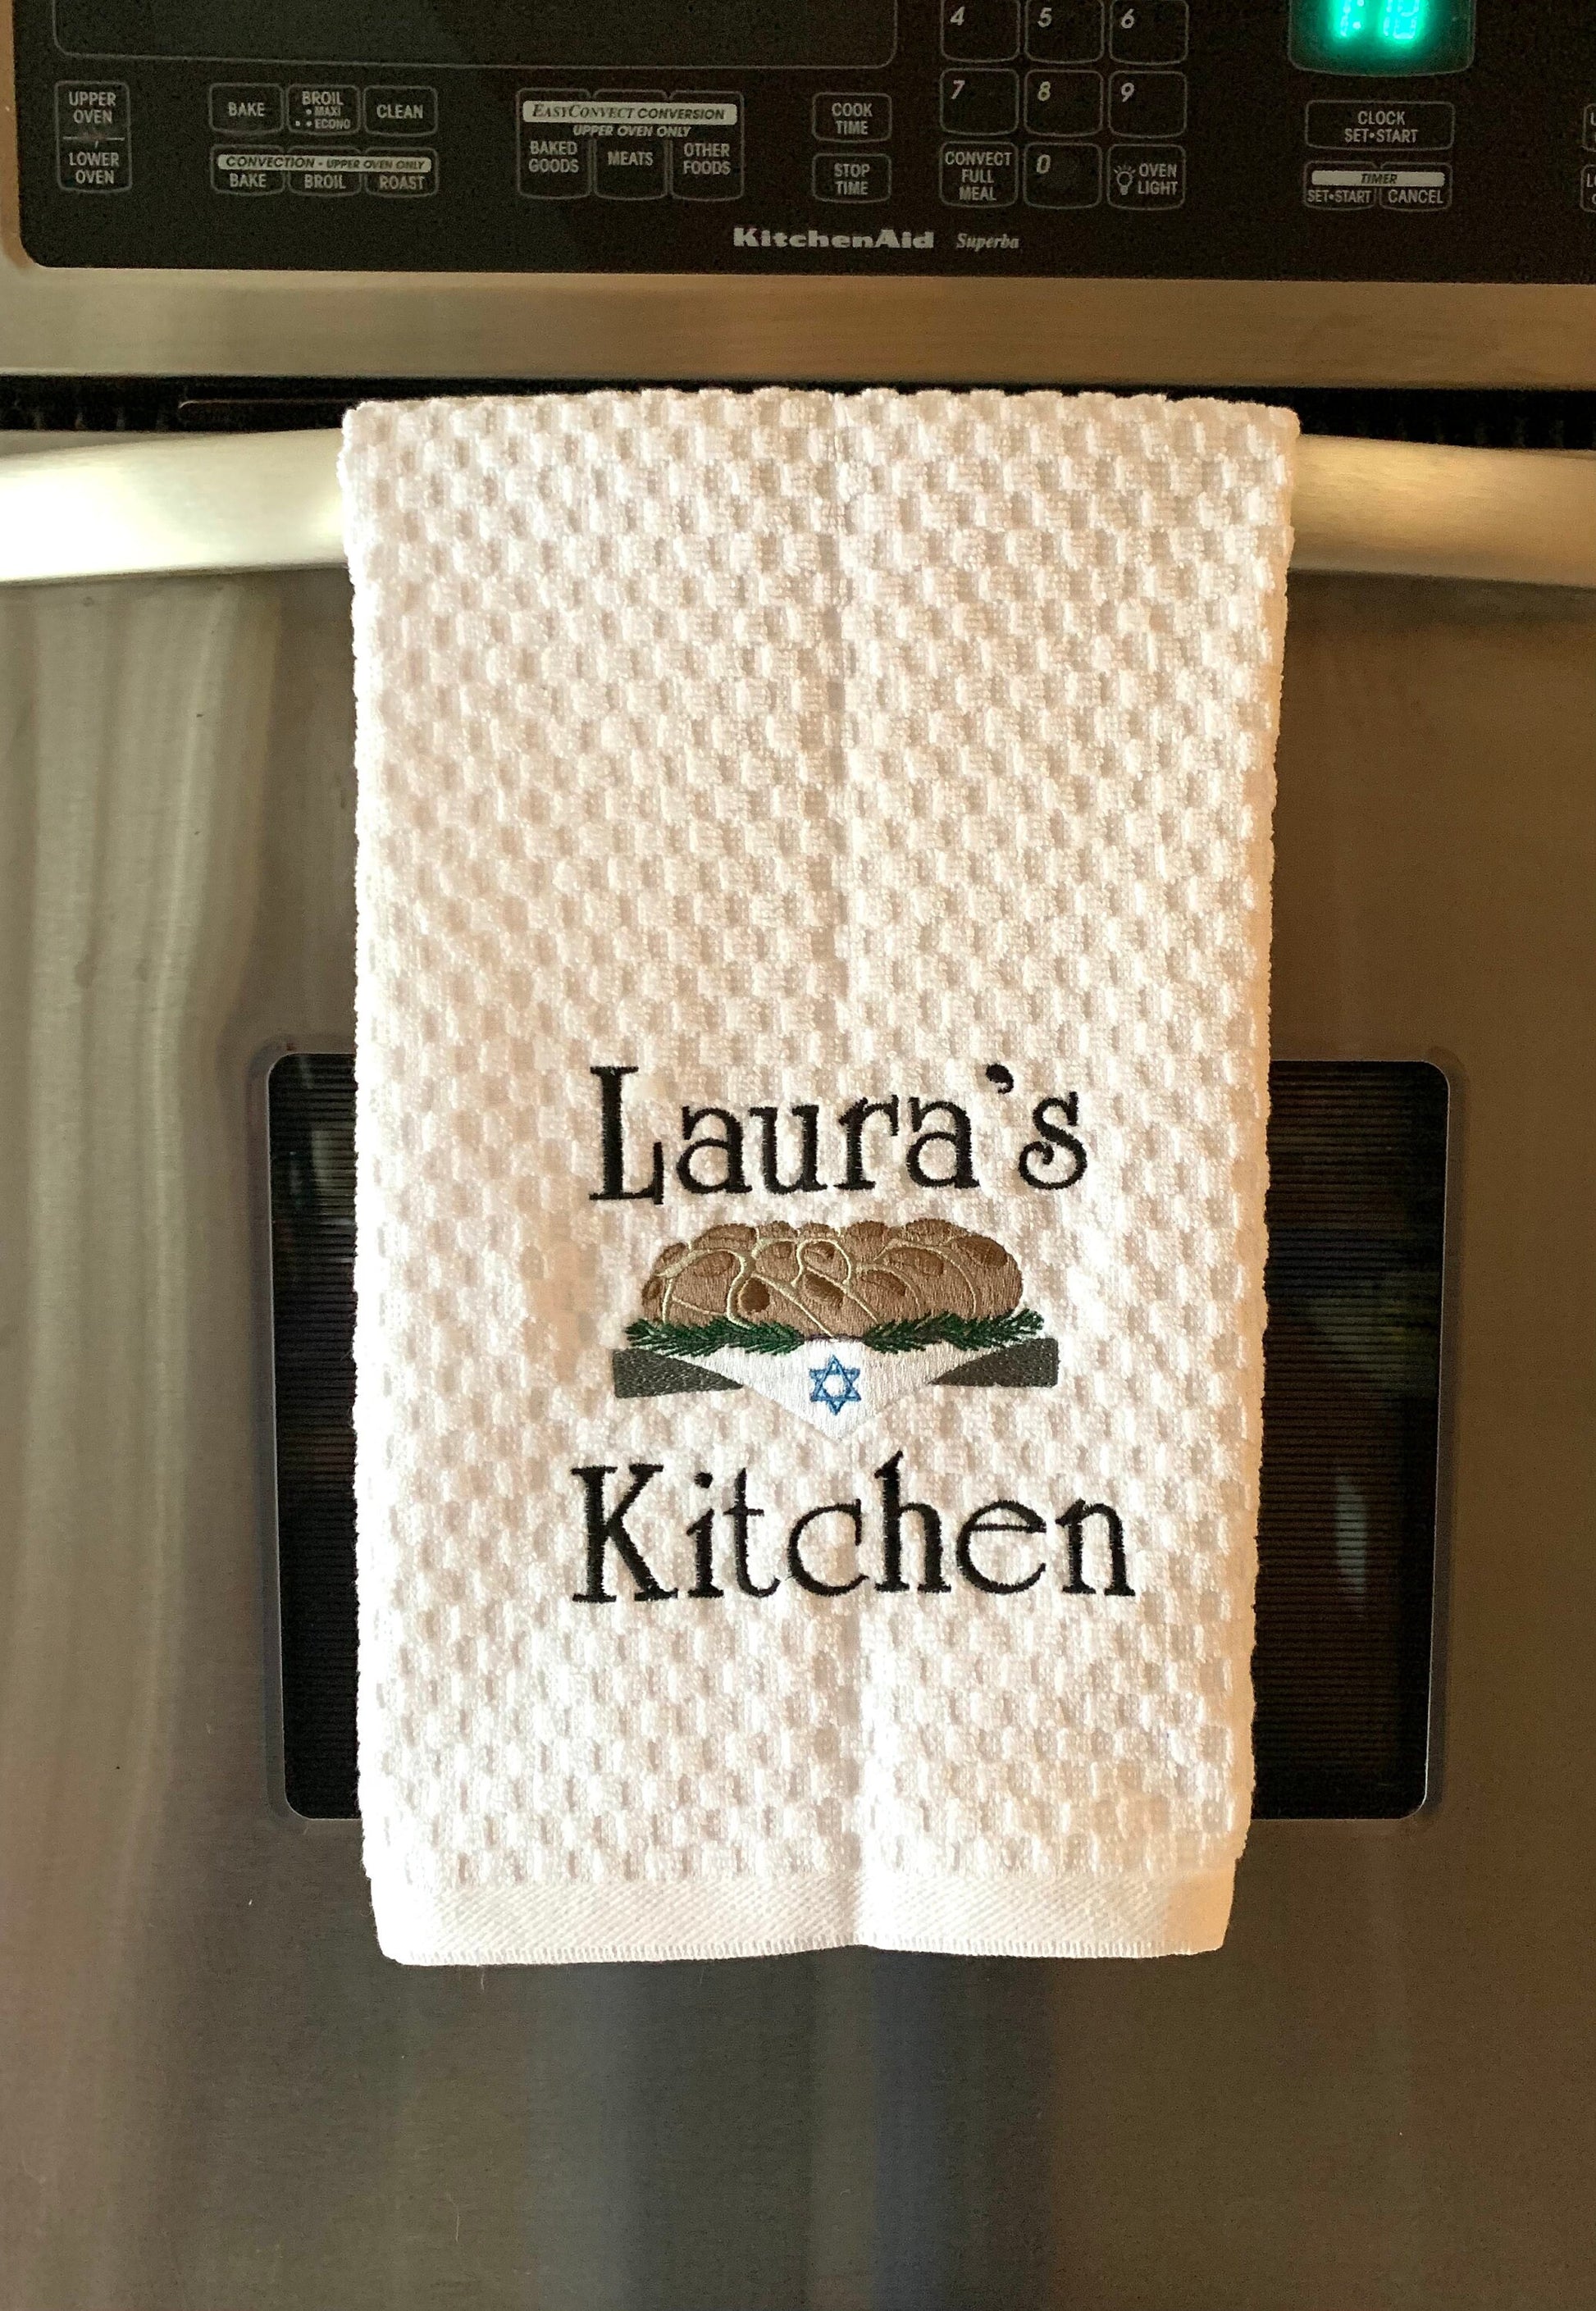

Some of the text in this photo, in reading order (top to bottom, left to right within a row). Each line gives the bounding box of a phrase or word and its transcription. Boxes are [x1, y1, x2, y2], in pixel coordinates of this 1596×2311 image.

[950, 6, 965, 25] 4
[1037, 7, 1052, 28] 5
[1120, 8, 1135, 29] 6
[951, 80, 965, 99] 7
[1037, 80, 1051, 101] 8
[1120, 82, 1135, 102] 9
[69, 91, 116, 107] UPPER
[302, 91, 344, 106] BROIL
[73, 109, 113, 125] OVEN
[228, 102, 266, 116] BAKE
[376, 104, 424, 120] CLEAN
[637, 107, 725, 120] CONVERSION
[832, 103, 873, 117] COOK
[1357, 111, 1406, 125] CLOCK
[573, 125, 691, 138] UPPER OVEN ONLY
[837, 121, 869, 135] TIME
[530, 140, 578, 156] BAKED
[683, 142, 731, 157] OTHER
[69, 153, 120, 168] LOWER
[226, 155, 315, 169] CONVECTION
[326, 157, 361, 169] UPPER
[363, 158, 394, 170] OVEN
[395, 159, 426, 171] ONLY
[528, 158, 580, 174] GOODS
[607, 151, 654, 166] MEATS
[944, 151, 1013, 166] CONVECT
[682, 160, 732, 175] FOODS
[833, 163, 871, 178] STOP
[1138, 162, 1178, 178] OVEN
[75, 170, 115, 185] OVEN
[229, 172, 267, 188] BAKE
[303, 174, 346, 189] BROIL
[378, 175, 426, 191] ROAST
[961, 169, 995, 184] FULL
[1360, 172, 1398, 185] TIMER
[836, 180, 869, 196] TIME
[959, 186, 997, 202] MEAL
[1138, 180, 1179, 196] LIGHT
[1388, 189, 1444, 204] CANCEL
[733, 226, 1020, 252] KitchenAid Superba
[588, 1063, 1088, 1206] Laura's
[571, 1450, 1136, 1604] Kitchen
